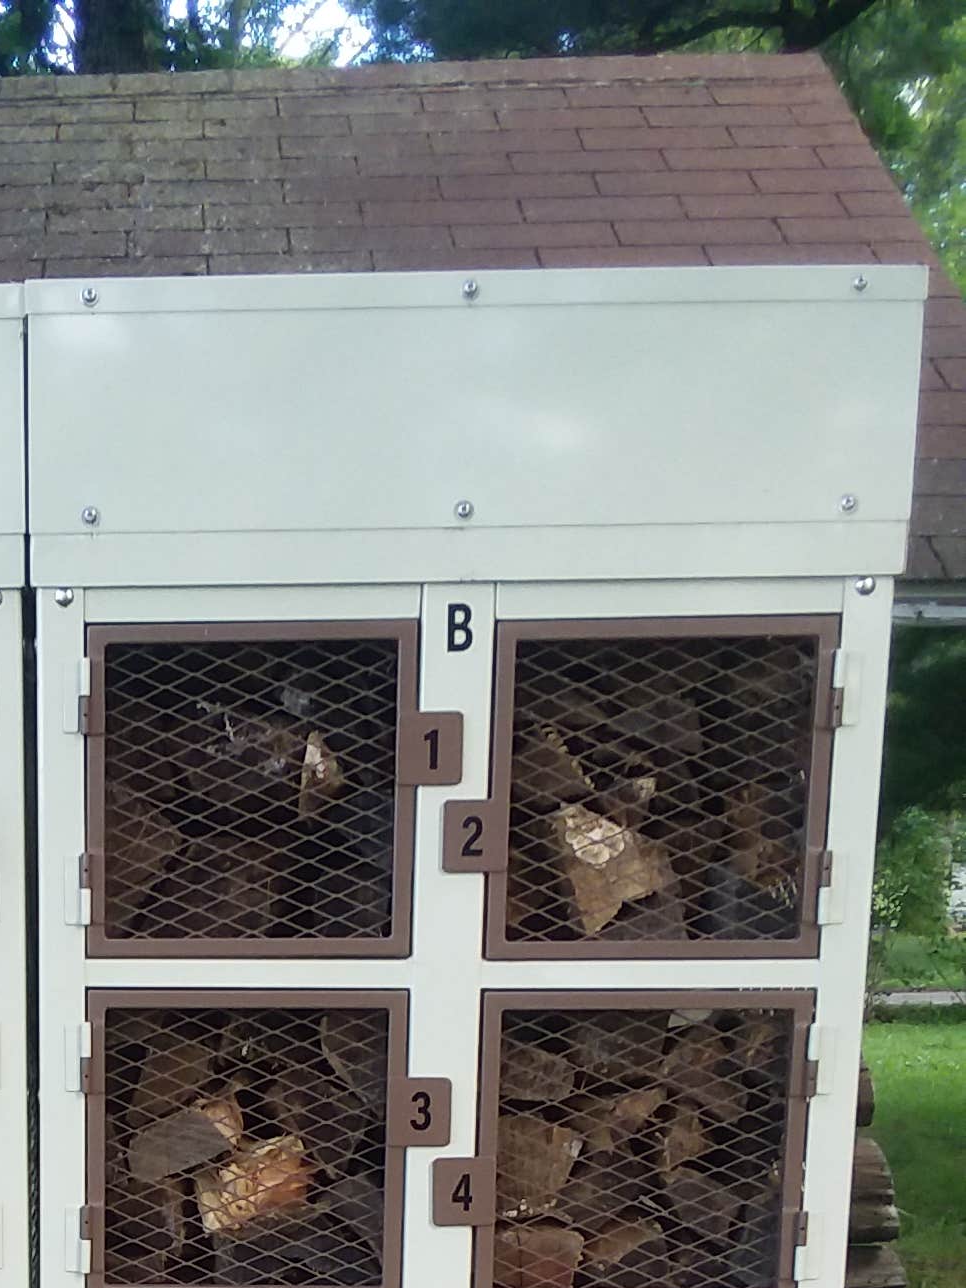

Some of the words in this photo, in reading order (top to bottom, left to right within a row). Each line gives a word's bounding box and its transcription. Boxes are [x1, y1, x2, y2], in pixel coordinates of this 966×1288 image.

[447, 603, 473, 652] B
[424, 729, 439, 770] 1
[461, 816, 483, 857] 2
[410, 1091, 431, 1130] 3
[452, 1174, 472, 1211] 4
